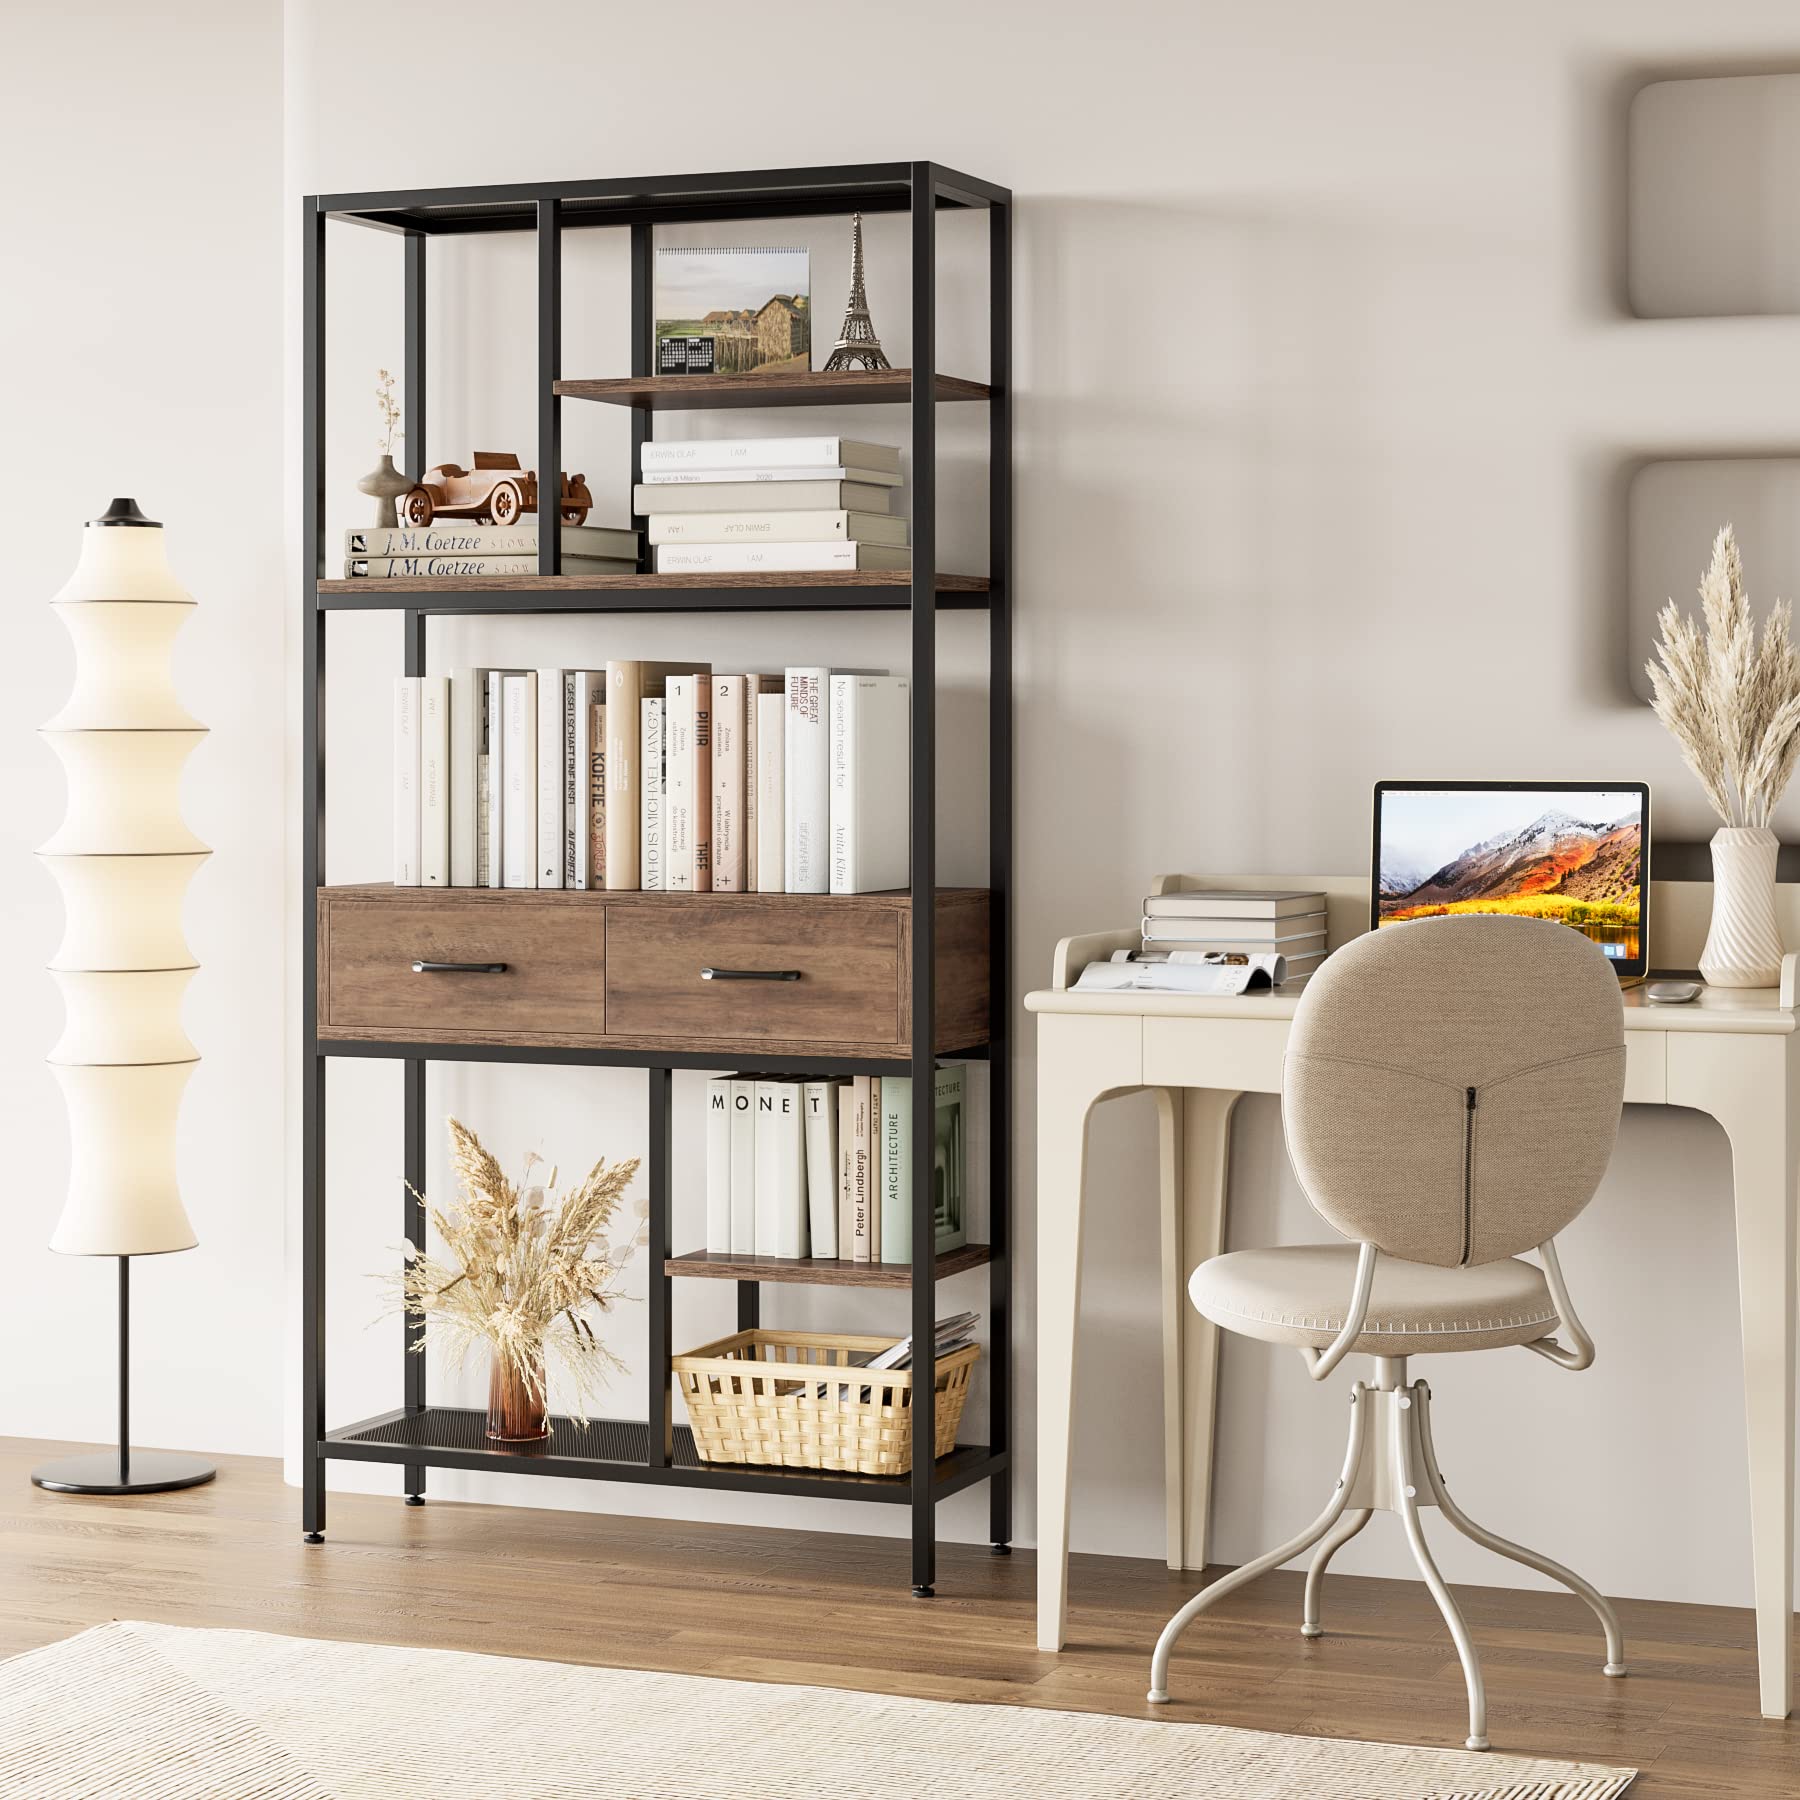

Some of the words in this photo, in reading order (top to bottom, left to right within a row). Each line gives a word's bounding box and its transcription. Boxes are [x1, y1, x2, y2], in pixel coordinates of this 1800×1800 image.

[756, 473, 773, 481] 2020
[426, 531, 482, 551] Coetzee
[428, 557, 485, 576] Coetzee
[674, 685, 682, 696] 1
[719, 685, 729, 697] 2
[790, 676, 799, 711] FUTURE
[799, 676, 809, 704] MINDS
[809, 676, 819, 694] THE
[836, 681, 846, 697] No
[799, 705, 809, 718] OF
[809, 695, 819, 725] GREAT
[836, 699, 846, 737] search
[647, 711, 659, 760] JANG?
[836, 739, 846, 769] result
[591, 752, 605, 808] KOFFIE
[836, 773, 846, 788] for
[647, 763, 659, 830] MICHAEL
[647, 832, 659, 846] IS
[836, 823, 847, 854] Anita
[647, 849, 659, 889] WHO
[695, 841, 709, 870] THEE
[935, 1081, 961, 1097] TECTURE
[889, 1113, 899, 1200] ARCHITECTURE
[855, 1149, 867, 1204] Lindbergh
[855, 1207, 865, 1237] Peter
